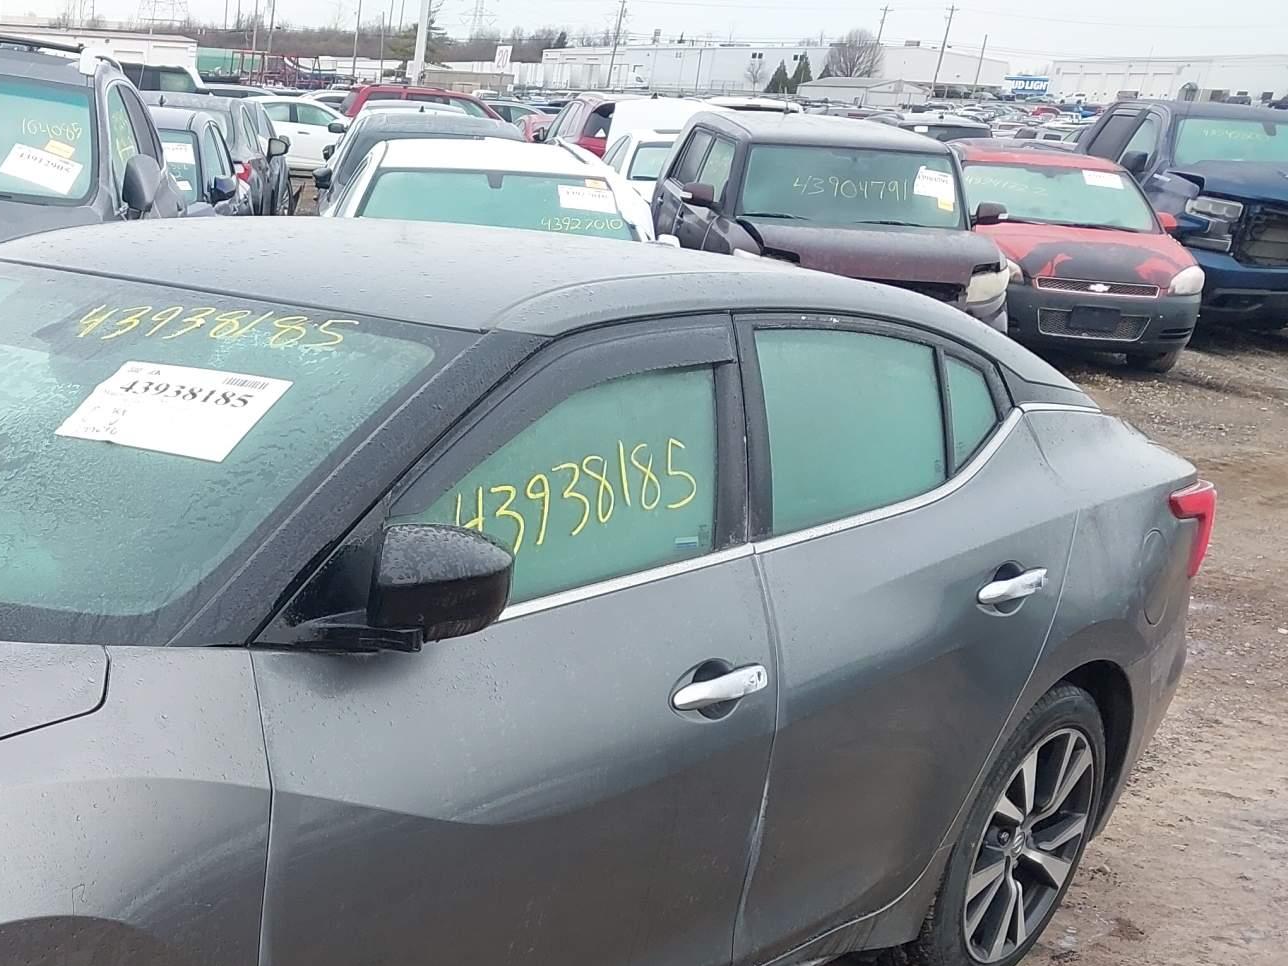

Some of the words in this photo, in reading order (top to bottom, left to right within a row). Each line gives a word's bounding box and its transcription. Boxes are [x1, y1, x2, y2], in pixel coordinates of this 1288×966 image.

[497, 49, 509, 68] 20
[1011, 79, 1025, 90] UD
[793, 176, 908, 200] 43904791
[540, 216, 623, 231] 43927010
[77, 304, 360, 347] 43938185
[120, 380, 254, 408] 43938185
[456, 438, 697, 555] 43938185
